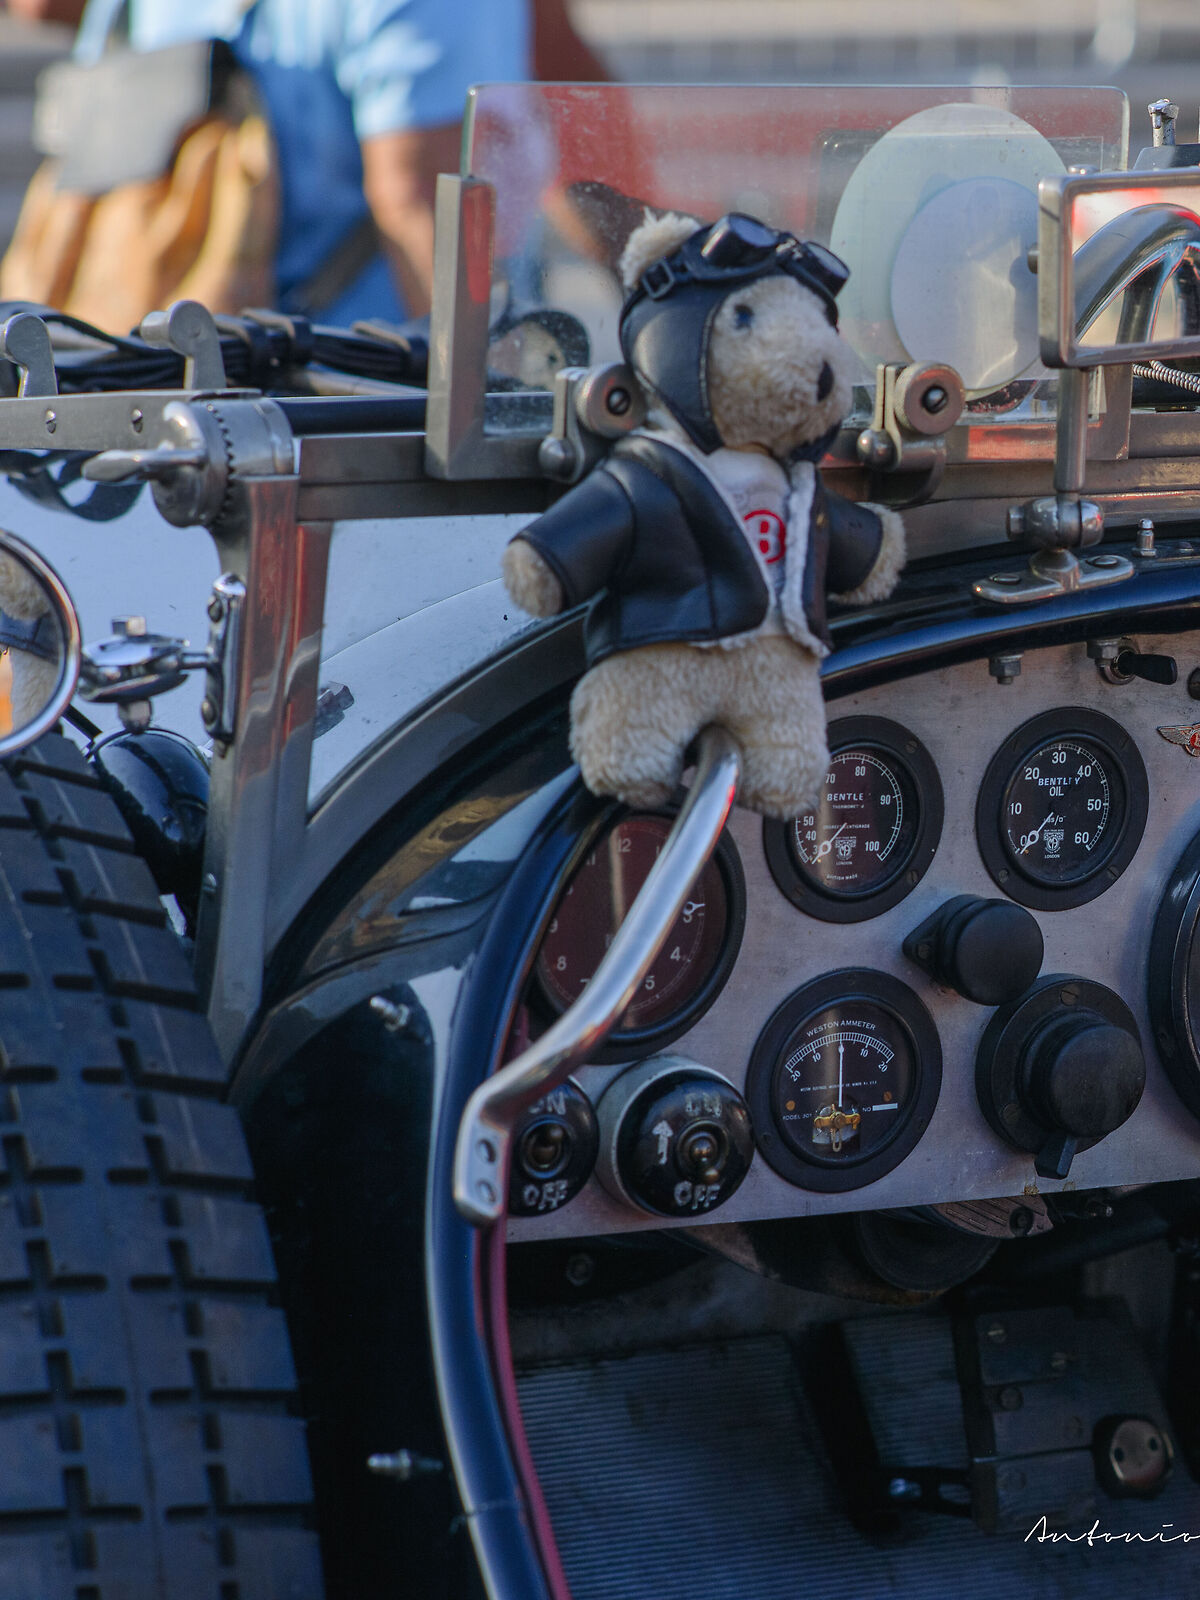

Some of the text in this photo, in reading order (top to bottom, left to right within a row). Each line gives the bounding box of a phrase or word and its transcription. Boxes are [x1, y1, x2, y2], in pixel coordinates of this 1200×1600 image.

[1051, 751, 1067, 764] 30
[854, 766, 866, 776] 80
[1024, 767, 1040, 780] 20
[1077, 765, 1092, 778] 40
[825, 774, 836, 784] 70
[826, 792, 872, 802] BENTLE
[1049, 786, 1064, 797] OIL
[880, 795, 891, 805] 90
[1087, 799, 1102, 811] 50
[1009, 802, 1022, 815] 10
[803, 816, 814, 826] 50
[805, 831, 816, 841] 40
[1020, 834, 1028, 847] 0
[1074, 831, 1090, 844] 60
[865, 841, 880, 852] 100
[670, 946, 681, 961] 4
[556, 956, 567, 971] 8
[645, 976, 656, 990] 5
[806, 1020, 876, 1037] WESTON AMMETER
[812, 1053, 821, 1063] 10
[860, 1048, 869, 1058] 10
[878, 1061, 888, 1073] 20
[791, 1070, 801, 1082] 20
[685, 1091, 723, 1118] ON
[522, 1179, 568, 1211] OFF
[673, 1181, 721, 1211] OFF
